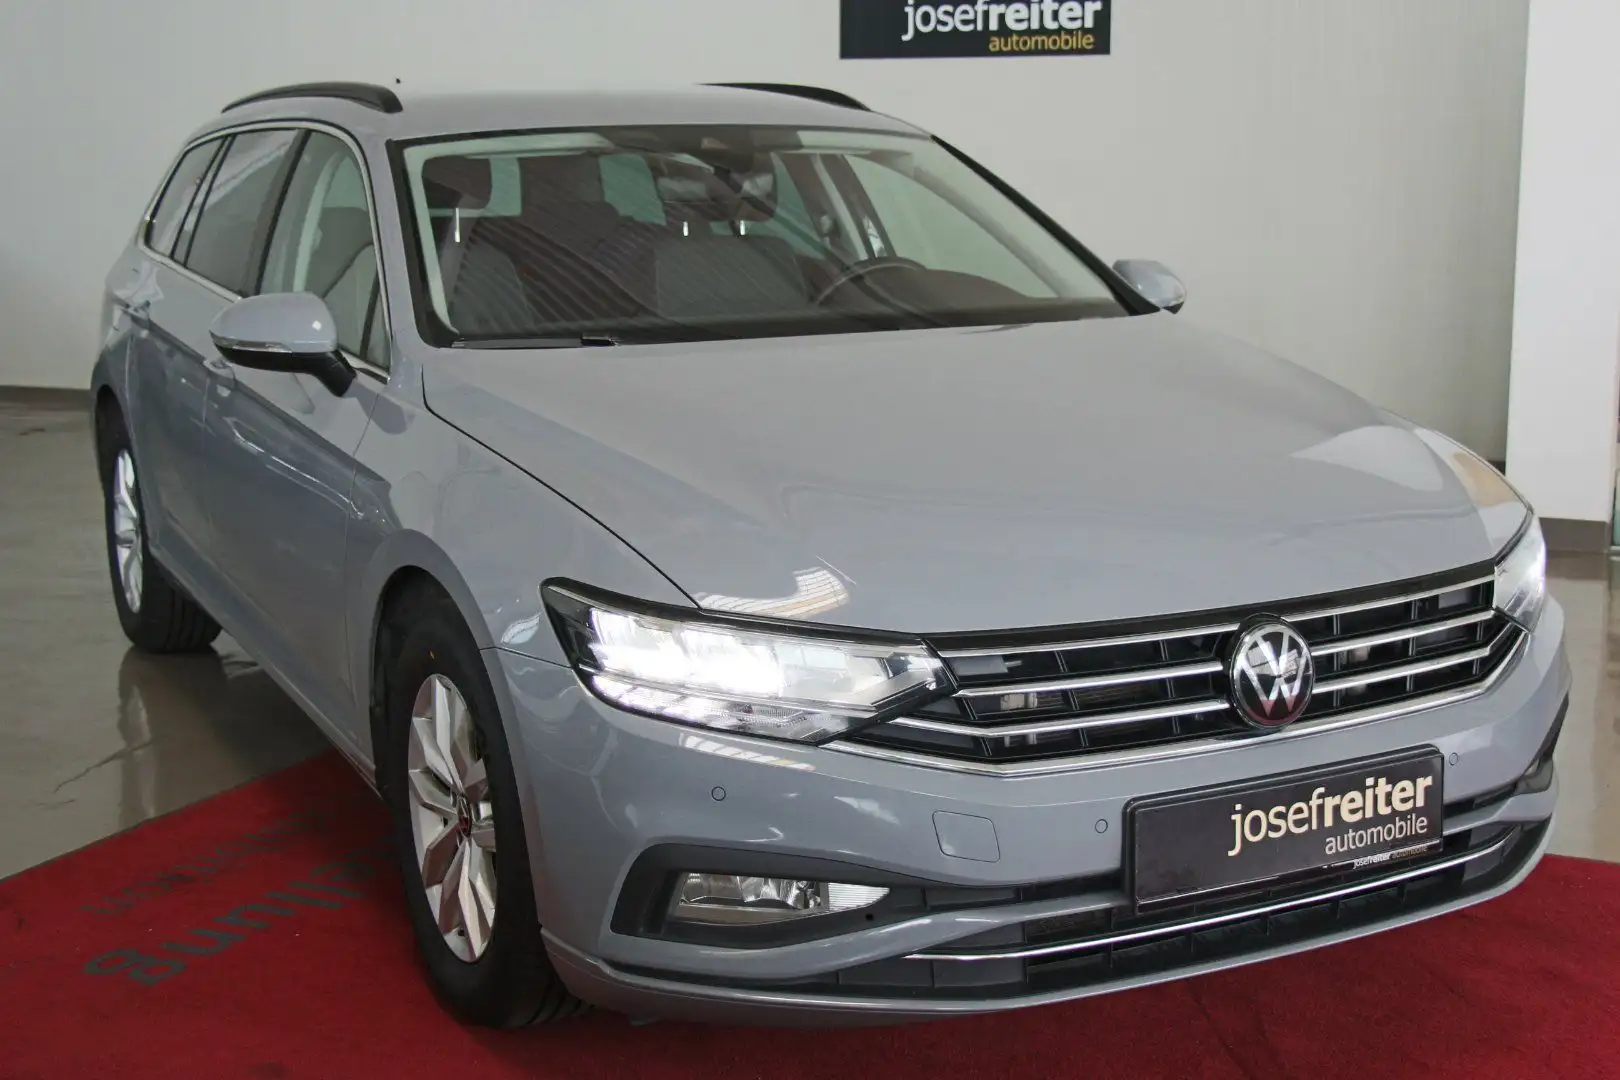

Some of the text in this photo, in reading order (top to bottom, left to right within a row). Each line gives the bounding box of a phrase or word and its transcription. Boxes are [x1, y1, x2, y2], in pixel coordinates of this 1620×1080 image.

[901, 0, 1103, 41] josefreiter
[988, 31, 1095, 52] automobile
[1227, 775, 1432, 856] josefreiter
[1325, 813, 1428, 855] automobile
[1352, 853, 1391, 869] josefreiter
